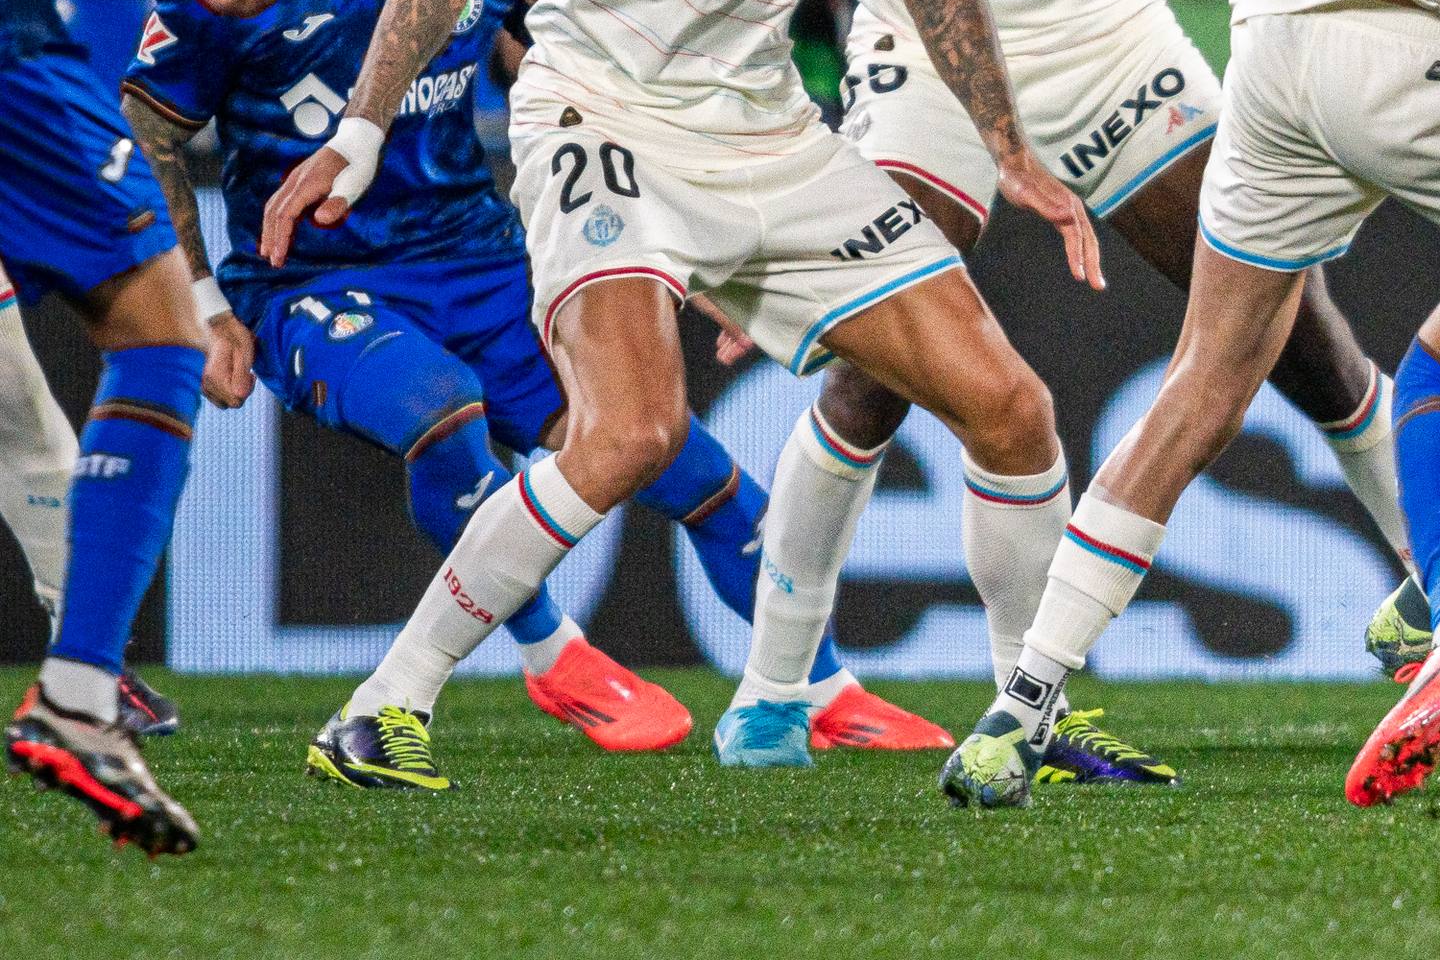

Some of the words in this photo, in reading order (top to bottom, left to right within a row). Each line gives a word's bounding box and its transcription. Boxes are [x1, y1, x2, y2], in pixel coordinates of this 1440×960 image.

[1060, 67, 1185, 178] INEXO
[552, 142, 640, 214] 20
[443, 566, 495, 624] 1928
